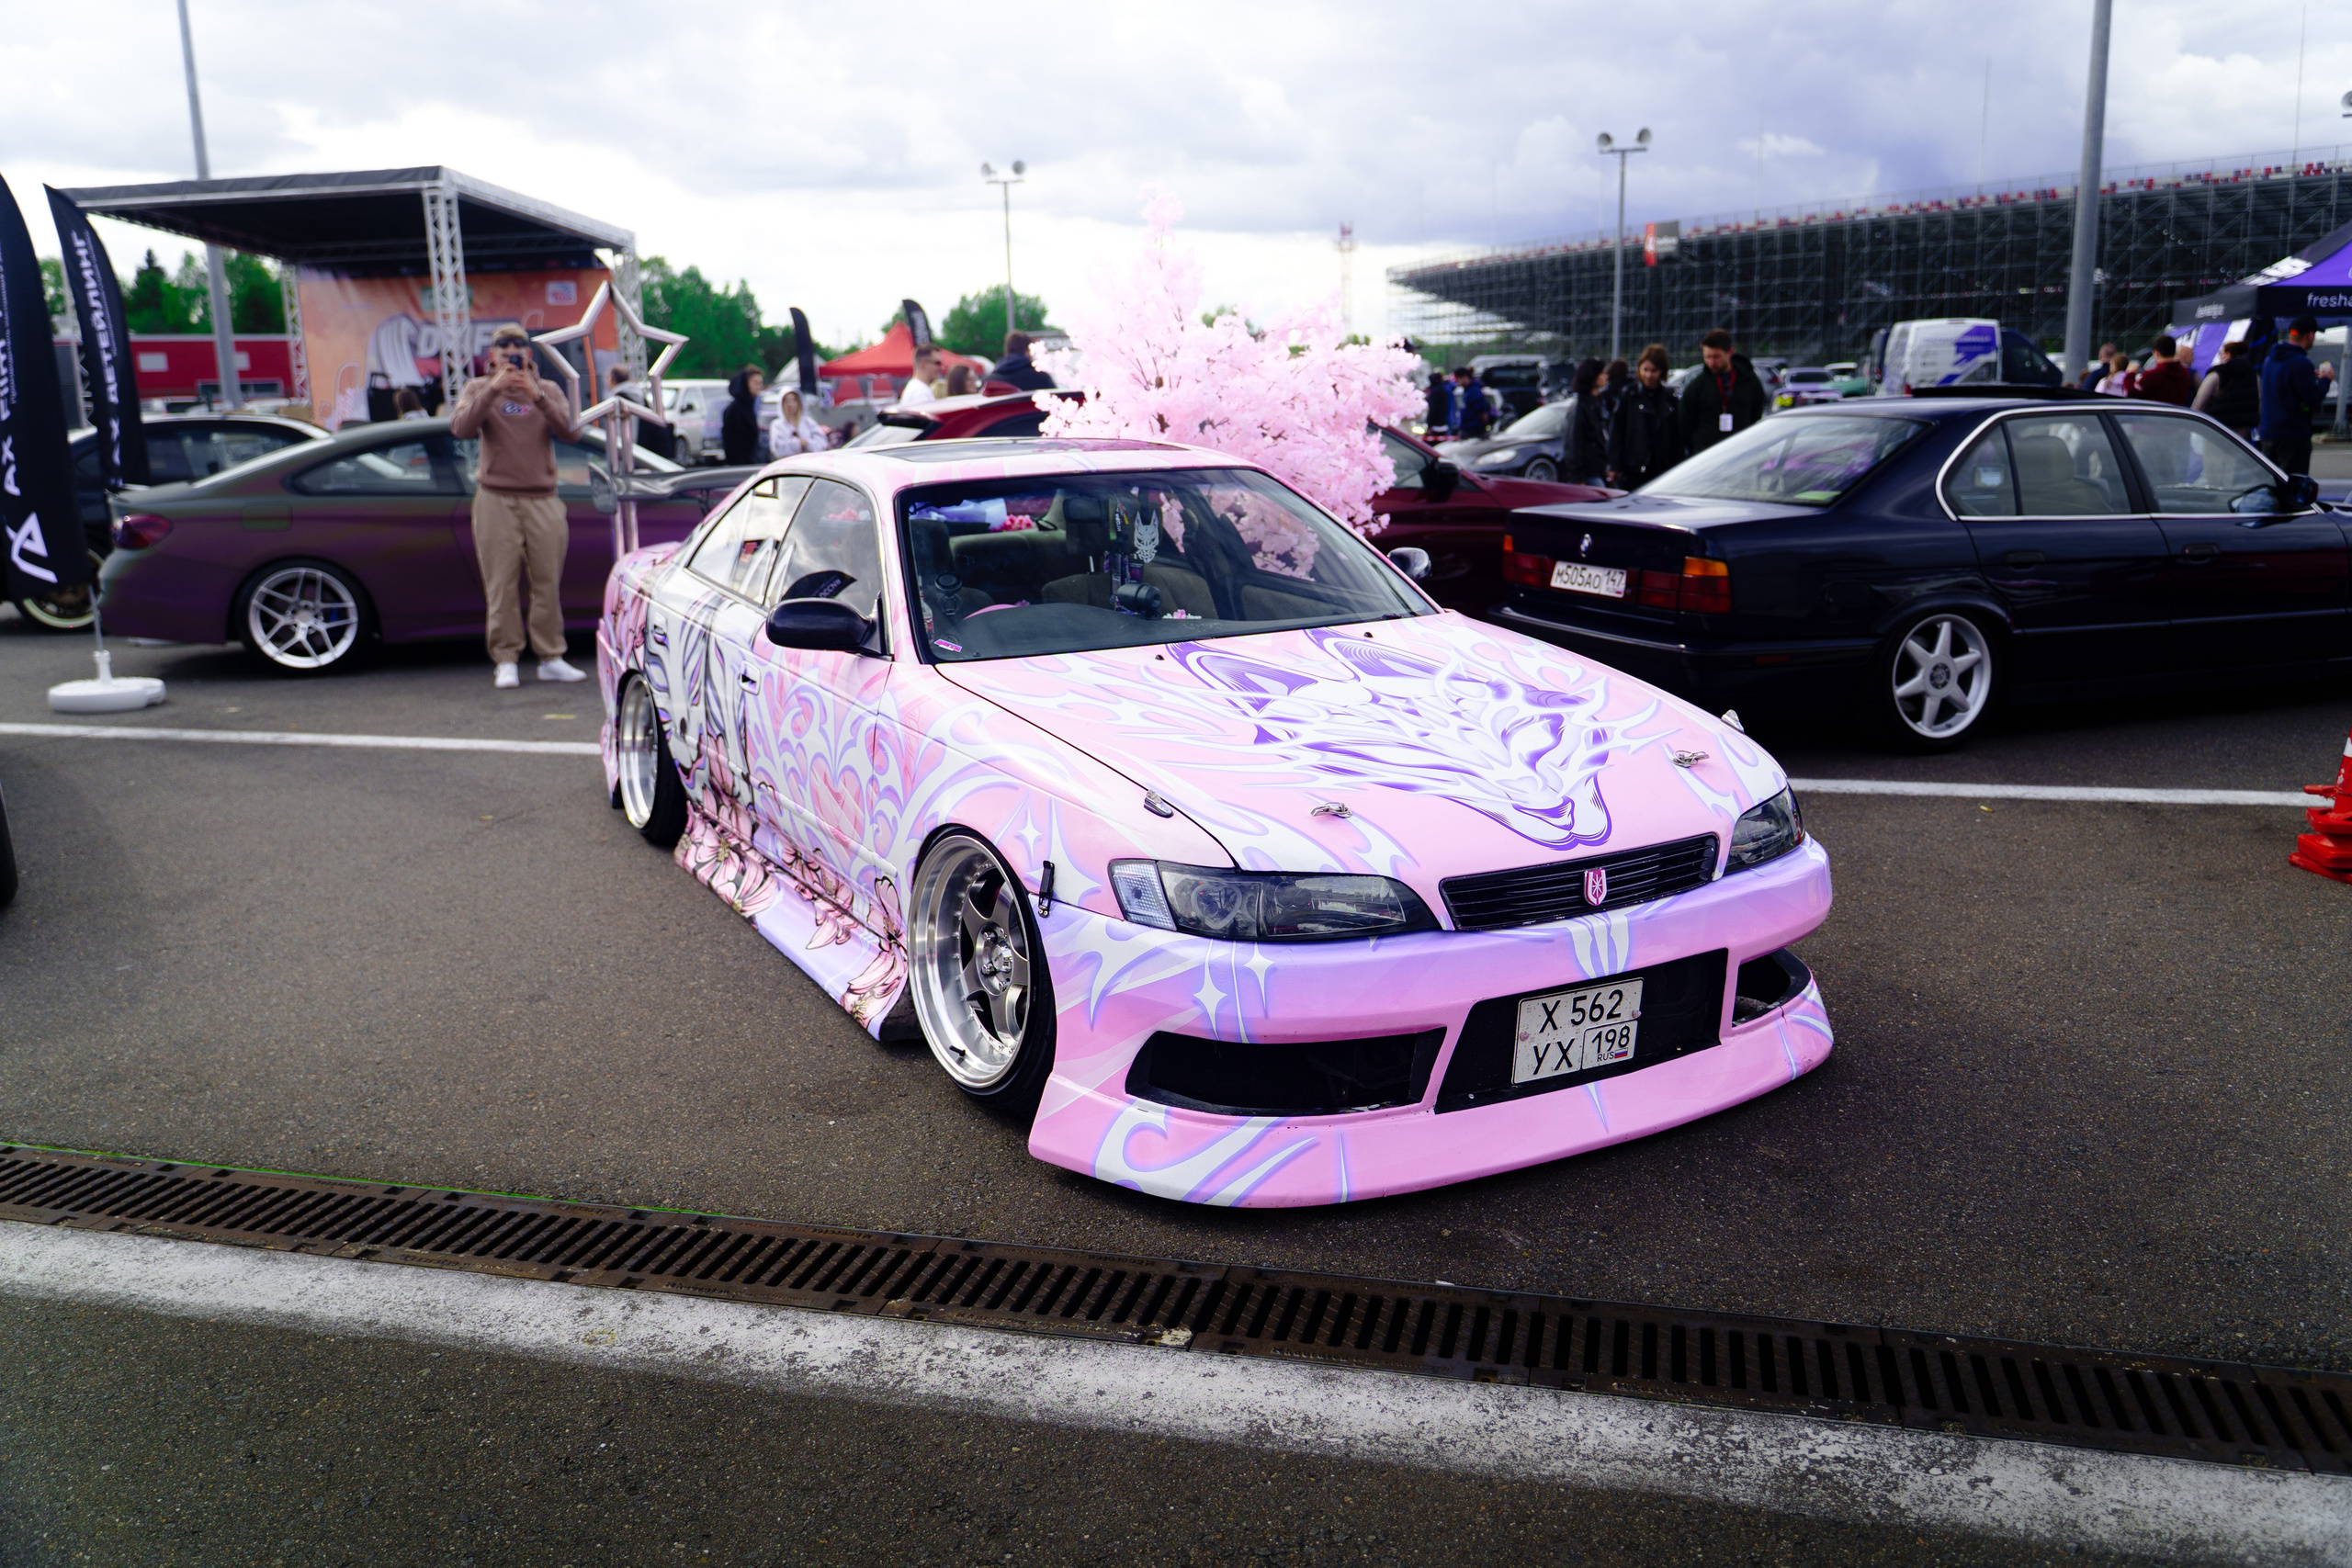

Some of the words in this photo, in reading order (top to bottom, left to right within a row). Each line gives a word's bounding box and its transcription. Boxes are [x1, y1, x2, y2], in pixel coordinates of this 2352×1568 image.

[71, 230, 119, 404] ДЕТЕЙЛИНГ
[2, 434, 21, 496] AX
[1539, 999, 1561, 1034] Х
[1570, 989, 1623, 1026] 562
[1532, 1038, 1575, 1076] УХ
[1591, 1025, 1631, 1054] 198
[1597, 1051, 1614, 1063] RUS
